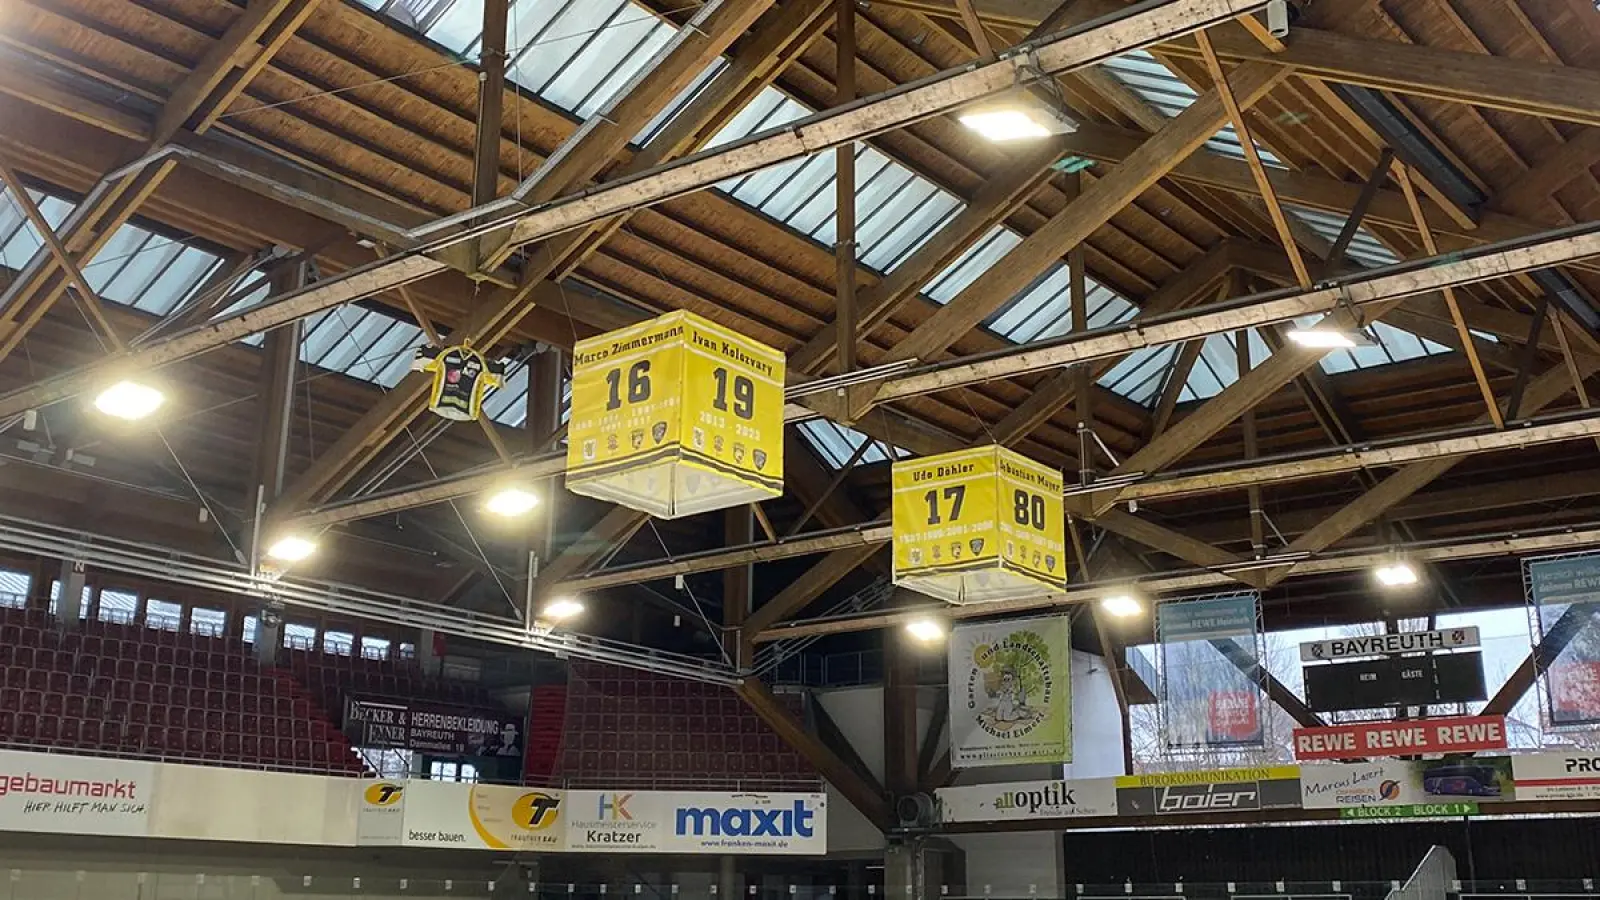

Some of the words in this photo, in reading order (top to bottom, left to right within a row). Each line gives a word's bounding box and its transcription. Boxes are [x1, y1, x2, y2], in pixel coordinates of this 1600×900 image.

[574, 349, 609, 367] Marco
[611, 325, 684, 356] Zimmermann
[692, 331, 717, 351] Ivan
[606, 359, 651, 411] 16
[712, 367, 754, 420] 19
[913, 470, 933, 481] Udo
[924, 485, 966, 525] 17
[1014, 488, 1045, 531] 80
[1332, 632, 1444, 656] BAYREUTH
[350, 701, 394, 725] BECKER
[411, 712, 500, 733] HERRENBEKLEIDUNG
[410, 728, 455, 741] BAYREUTH
[976, 715, 1010, 739] Michael
[1298, 733, 1357, 753] REWE
[1365, 728, 1428, 749] REWE
[1437, 723, 1502, 745] REWE
[1305, 779, 1350, 796] Marcus
[23, 800, 52, 813] HIER
[53, 800, 90, 814] HILFT
[90, 802, 118, 813] MAN
[1336, 794, 1377, 803] REISEN
[676, 799, 814, 837] maxit
[1358, 806, 1391, 817] BLOCK
[1394, 807, 1401, 816] 2
[1414, 805, 1448, 815] BLOCK
[1454, 804, 1460, 814] 1
[409, 829, 437, 841] besser
[438, 831, 466, 842] bauen.
[587, 830, 642, 843] Kratzer
